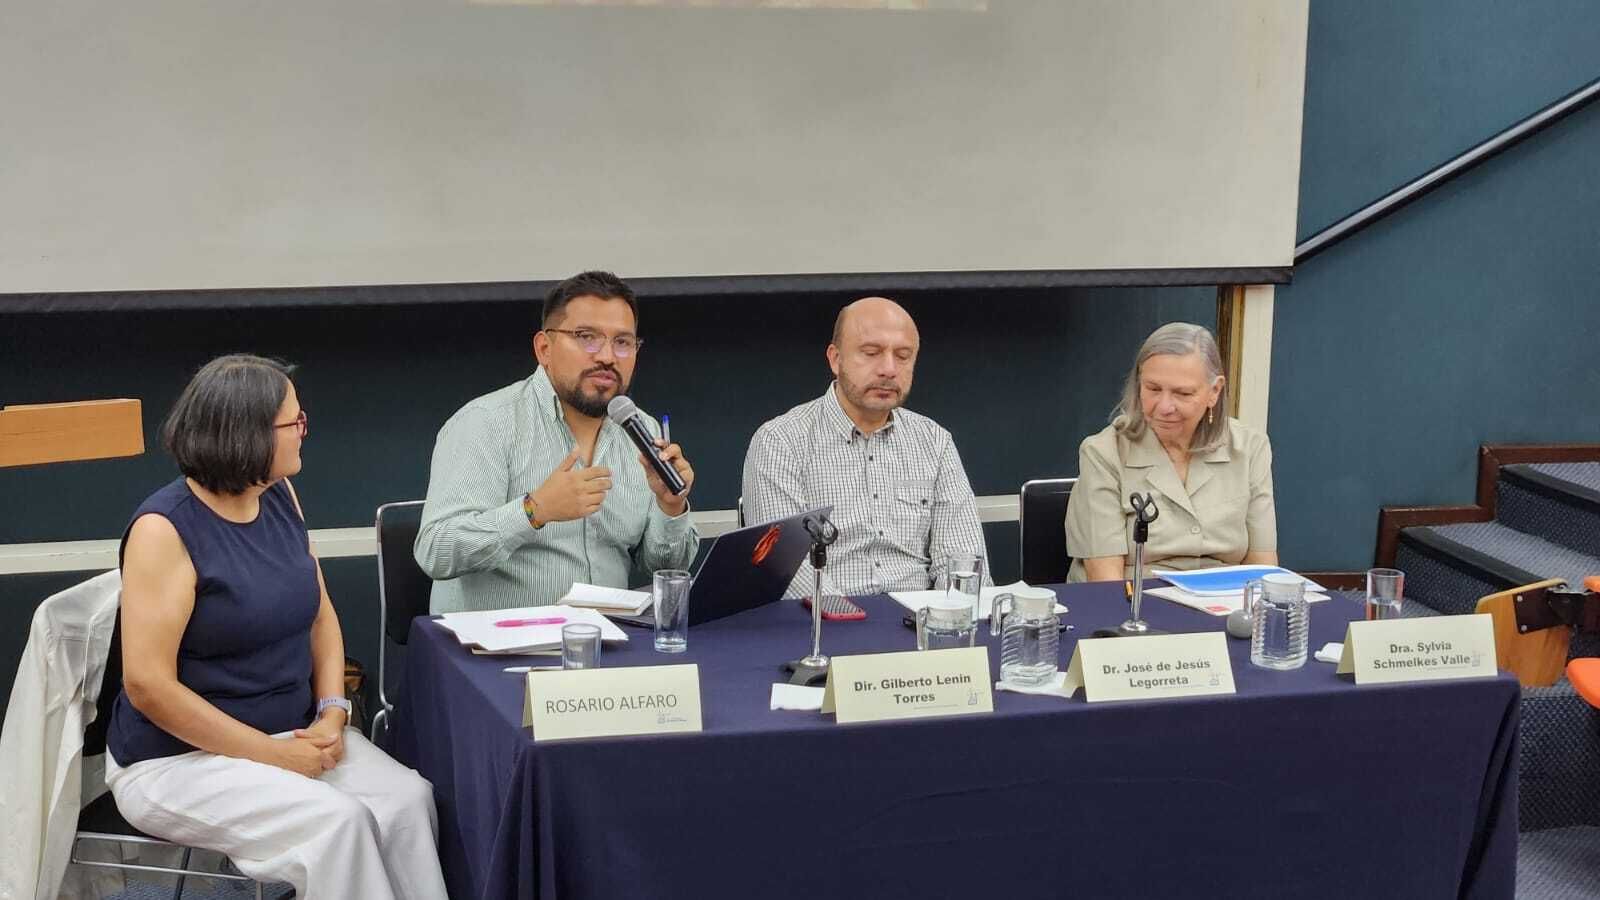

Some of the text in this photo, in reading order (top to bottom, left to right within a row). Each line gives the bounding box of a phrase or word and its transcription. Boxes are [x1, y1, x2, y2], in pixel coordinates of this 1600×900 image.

[1389, 640, 1452, 654] Dra. Sylvia
[1102, 658, 1211, 674] Dr. José de Jesús
[1373, 657, 1438, 670] Schmelkes
[1441, 654, 1471, 665] Valle
[854, 673, 971, 692] Dir. Gilberto Lenin
[1129, 675, 1189, 689] Legorreta
[545, 694, 678, 714] ROSARIO ALFARO
[893, 693, 936, 704] Torres
